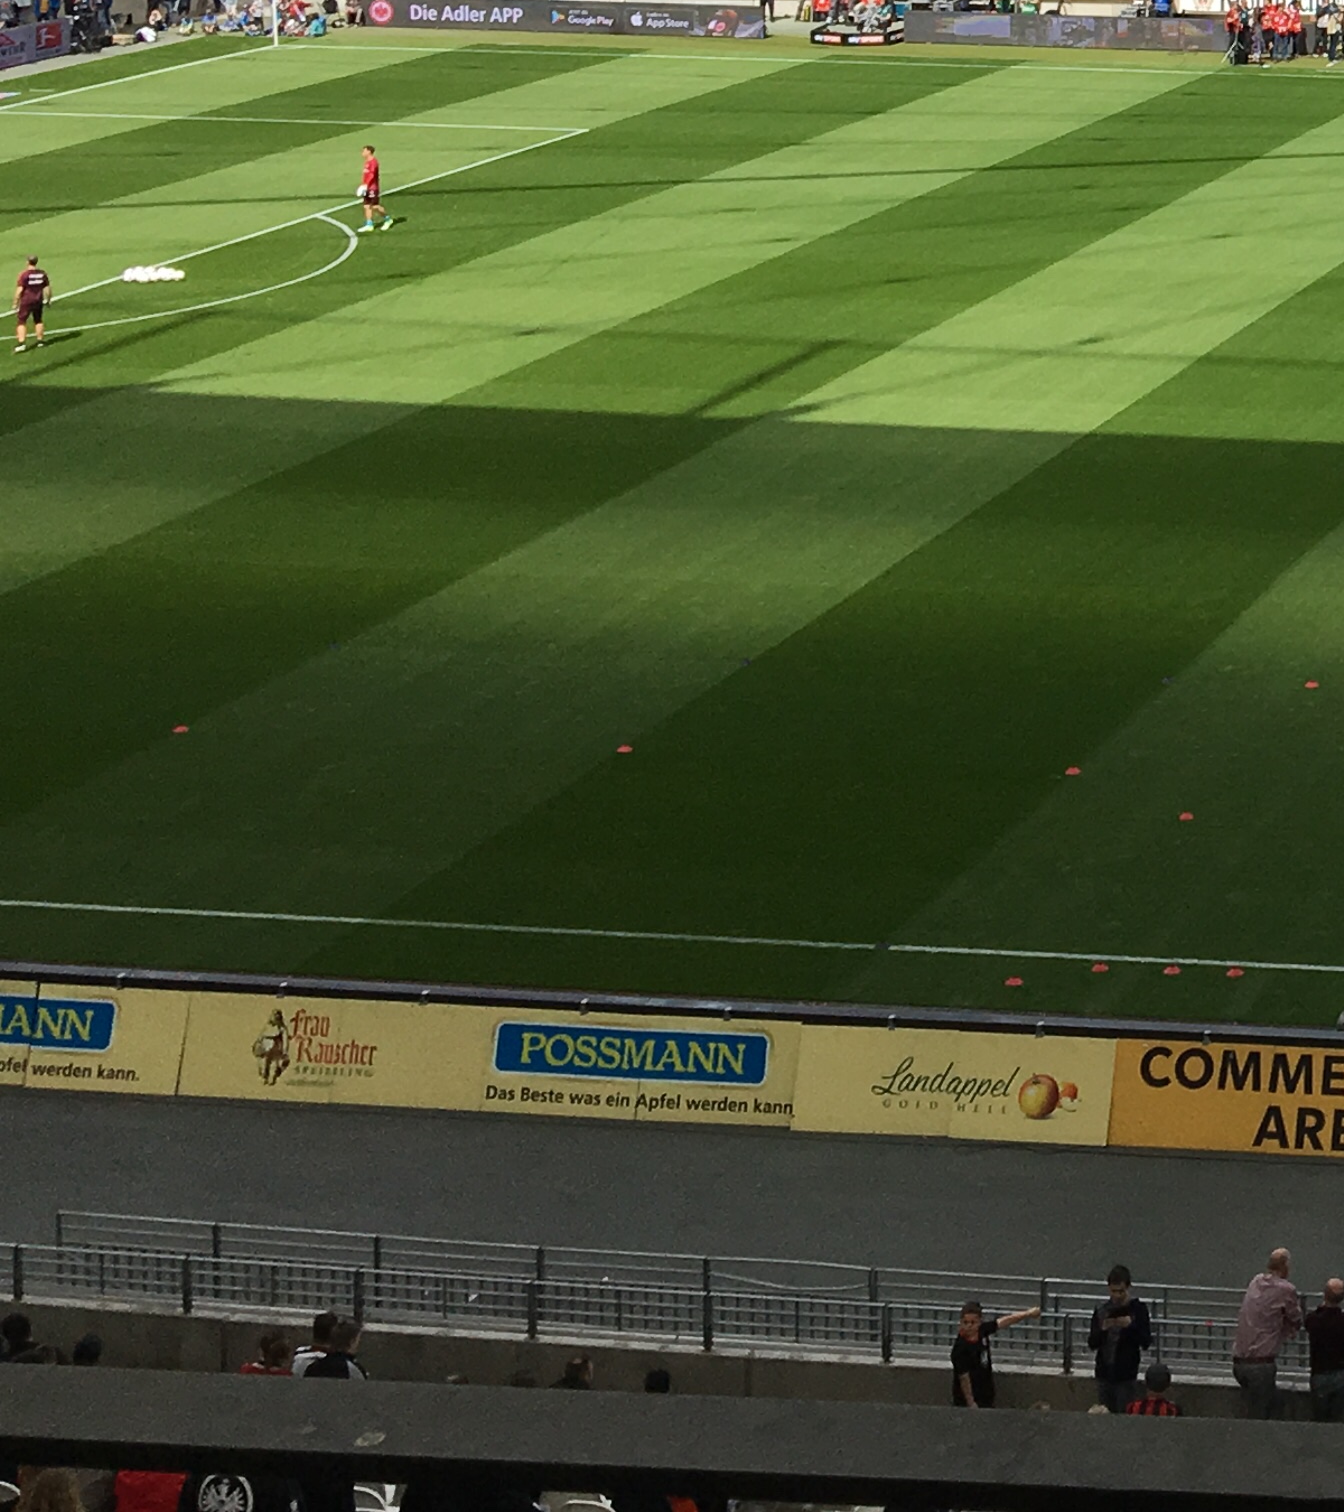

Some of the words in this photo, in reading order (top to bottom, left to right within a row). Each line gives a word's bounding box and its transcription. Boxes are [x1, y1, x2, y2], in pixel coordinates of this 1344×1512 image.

[410, 4, 438, 21] Die
[441, 4, 487, 23] Adler
[488, 6, 524, 24] APP
[0, 1004, 94, 1041] ANN
[520, 1032, 747, 1076] POSSMANN
[32, 1063, 92, 1078] werden
[871, 1056, 1021, 1103] Landappel
[485, 1085, 516, 1101] Das
[520, 1087, 564, 1104] Beste
[568, 1092, 600, 1106] was
[605, 1091, 631, 1107] ein
[635, 1093, 681, 1111] Apfel
[685, 1096, 748, 1112] werden
